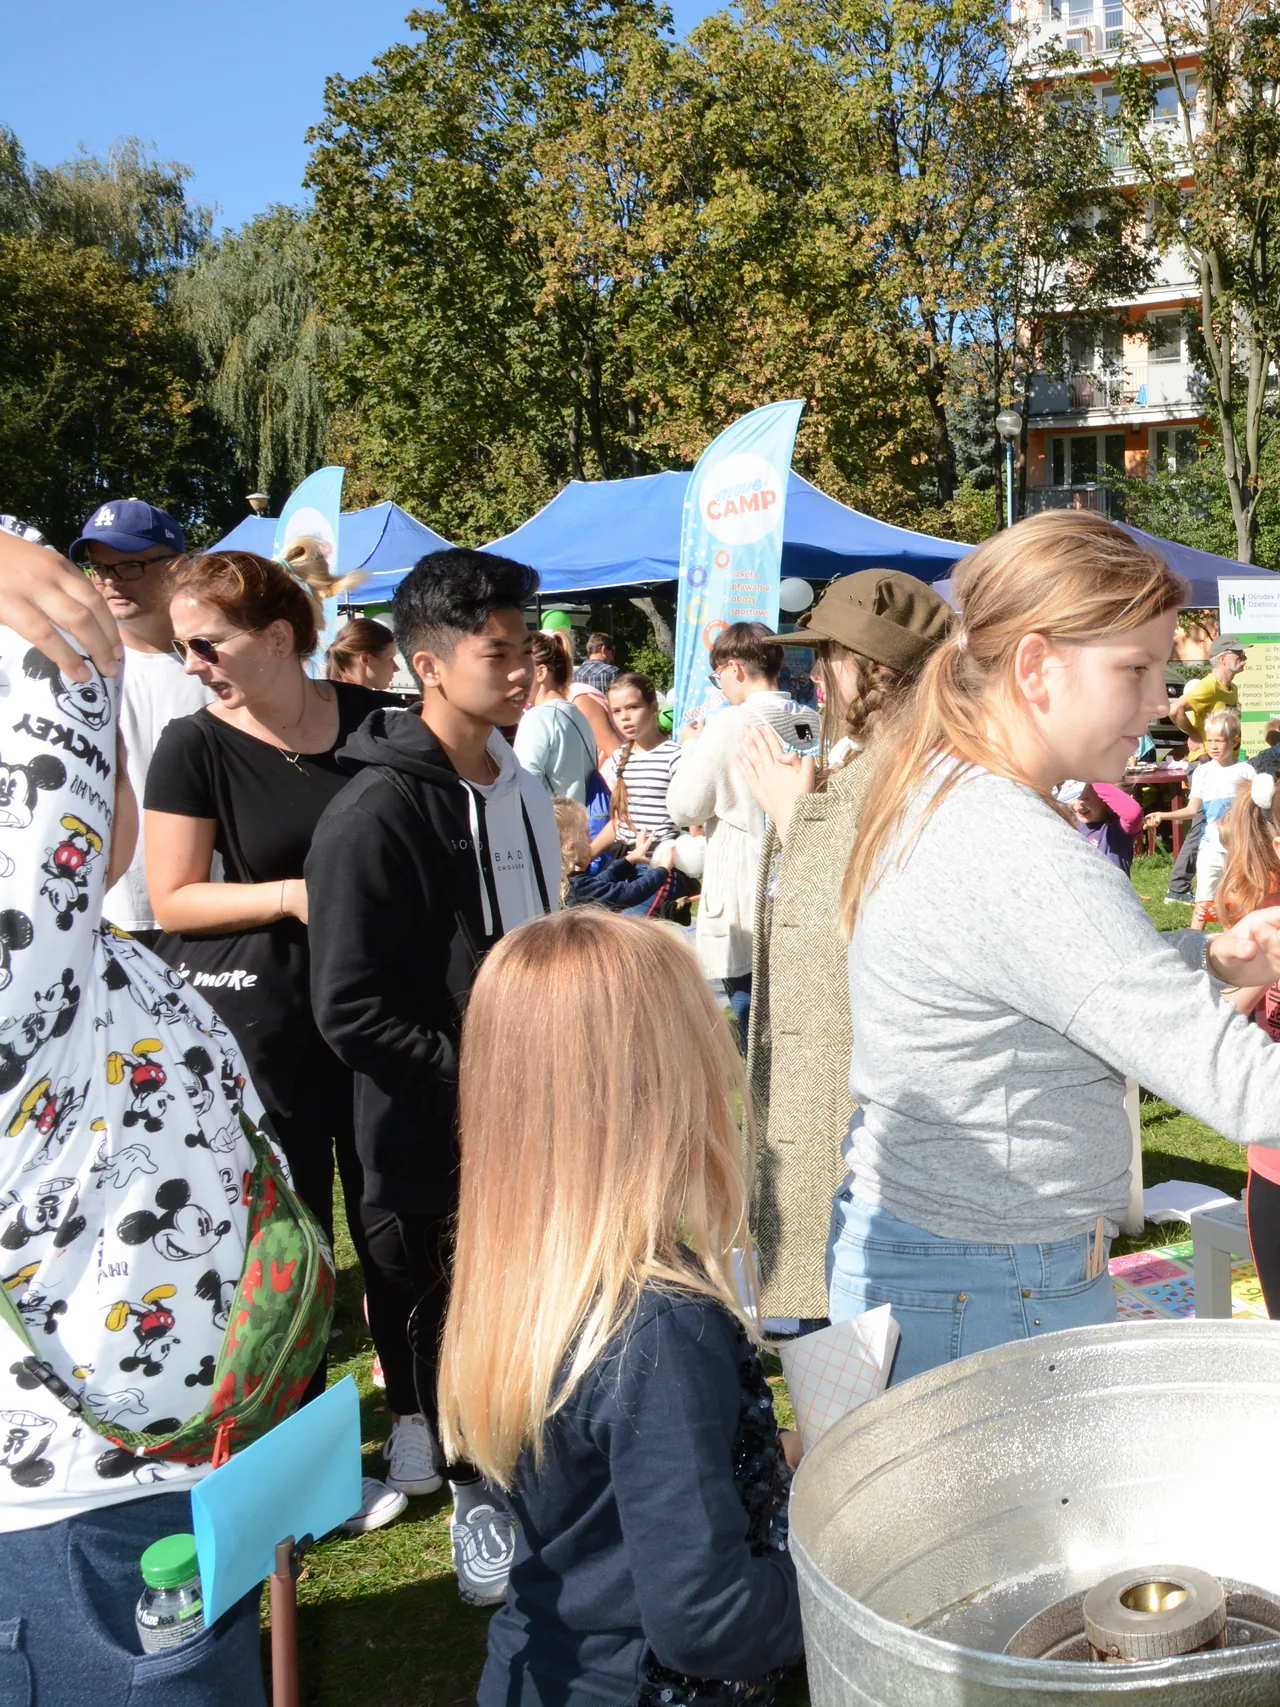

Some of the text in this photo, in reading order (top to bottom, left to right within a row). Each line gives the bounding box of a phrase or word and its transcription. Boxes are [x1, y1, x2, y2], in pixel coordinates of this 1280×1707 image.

[706, 489, 777, 521] CAMP
[94, 505, 116, 527] LA
[732, 570, 758, 579] szkoła
[731, 582, 771, 592] pływania
[731, 595, 757, 605] obozy
[1248, 593, 1274, 601] Ośrodek
[1248, 601, 1278, 609] Dzielnicy
[730, 607, 772, 617] sportowe
[1242, 682, 1263, 690] Pomocy
[12, 713, 112, 781] MICKEY
[494, 850, 524, 862] BAD
[141, 1609, 175, 1627] fuzetea
